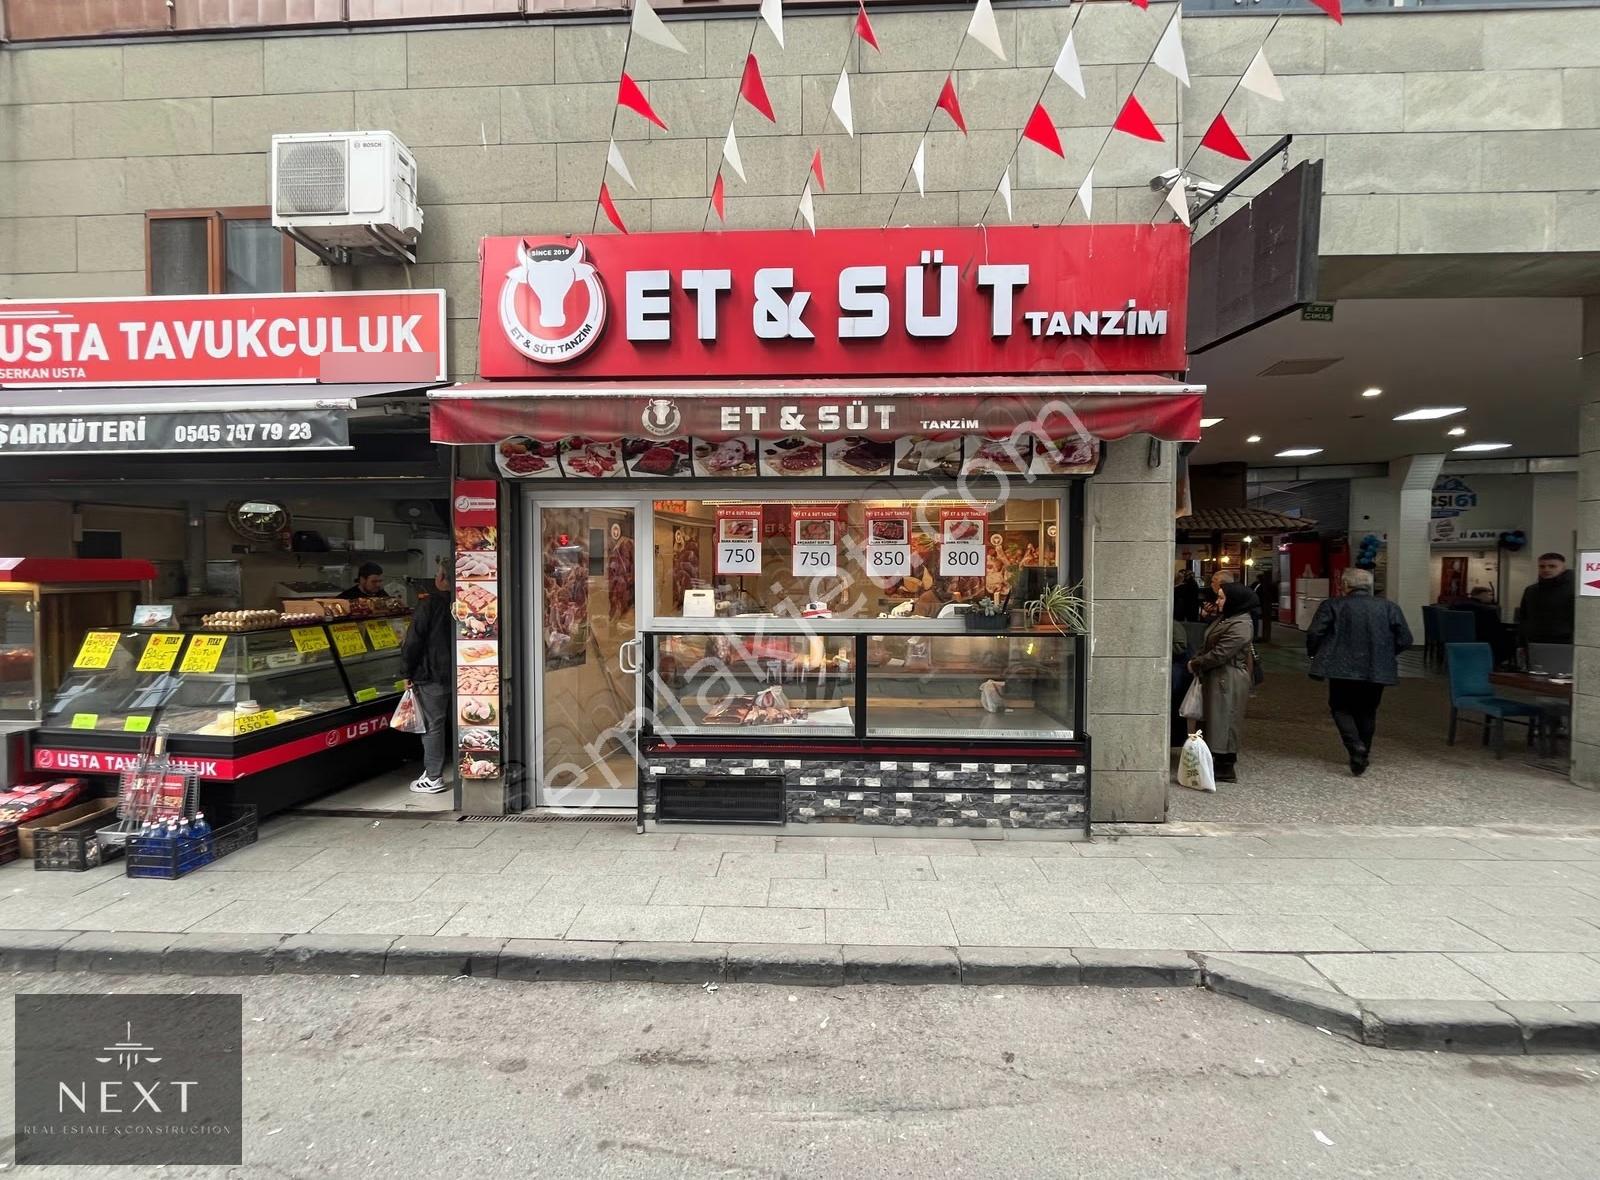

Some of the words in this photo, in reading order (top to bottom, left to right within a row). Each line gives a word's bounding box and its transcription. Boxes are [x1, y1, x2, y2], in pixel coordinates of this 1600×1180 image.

[626, 269, 731, 341] ET
[753, 267, 815, 338] &
[838, 249, 1030, 338] SÜT
[1025, 299, 1168, 336] TANZİM
[0, 322, 109, 363] USTA
[120, 314, 424, 360] TAVUKCULUK
[510, 326, 525, 341] ET
[523, 339, 532, 350] &
[532, 342, 556, 355] SÜT
[557, 323, 593, 353] TANZİM
[0, 367, 49, 379] SERKAN
[52, 367, 87, 379] USTA
[720, 406, 767, 431] ET
[779, 405, 807, 431] &
[818, 400, 896, 431] SÜT
[920, 417, 979, 430] TANZİM
[174, 424, 220, 443] 0545
[226, 423, 254, 442] 747
[260, 423, 282, 441] 79
[289, 422, 312, 440] 23
[724, 548, 755, 563] 750
[800, 551, 831, 566] 750
[873, 550, 905, 566] 850
[947, 550, 980, 566] 800
[347, 717, 390, 739] USTA
[57, 752, 100, 769] USTA
